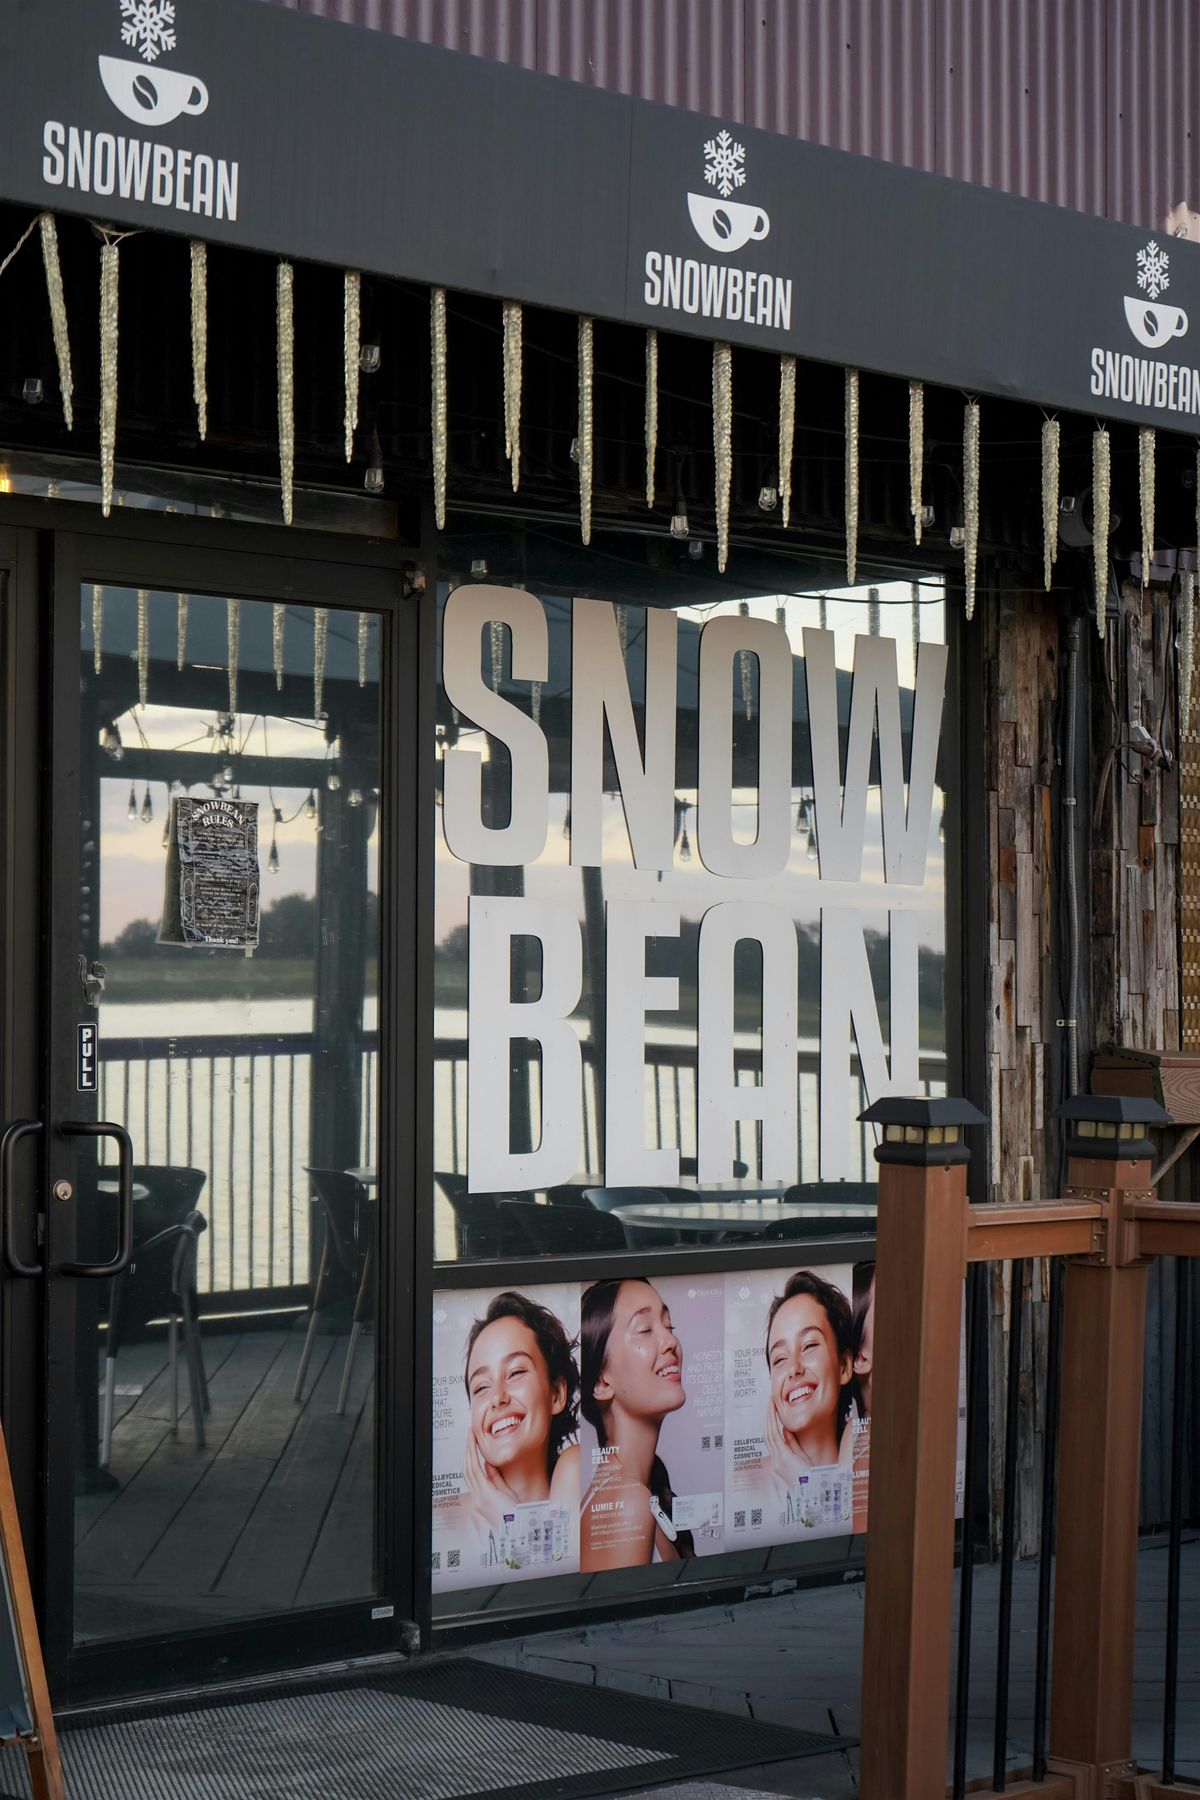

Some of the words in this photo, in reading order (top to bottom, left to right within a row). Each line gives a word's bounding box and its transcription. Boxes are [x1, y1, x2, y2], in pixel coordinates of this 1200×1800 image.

[42, 120, 239, 221] SNOWBEAN
[644, 251, 792, 330] SNOWBEAN
[442, 583, 949, 886] SNOW
[192, 801, 246, 825] SNOWBEAN
[202, 815, 234, 828] RULES
[467, 895, 920, 1194] BEAN
[82, 1028, 92, 1086] PULL
[734, 1349, 751, 1358] YOUR
[751, 1347, 766, 1356] SKIN
[734, 1358, 752, 1368] TELLS
[734, 1368, 752, 1378] WHAT
[449, 1375, 465, 1384] SKIN
[734, 1388, 757, 1398] WORTH
[852, 1425, 868, 1434] CELL
[591, 1446, 620, 1456] BEAUTY
[734, 1445, 756, 1453] MEDICAL
[591, 1455, 610, 1465] CELL
[734, 1451, 762, 1460] COSMETICS
[591, 1502, 614, 1512] LUMIE
[615, 1500, 625, 1510] FX
